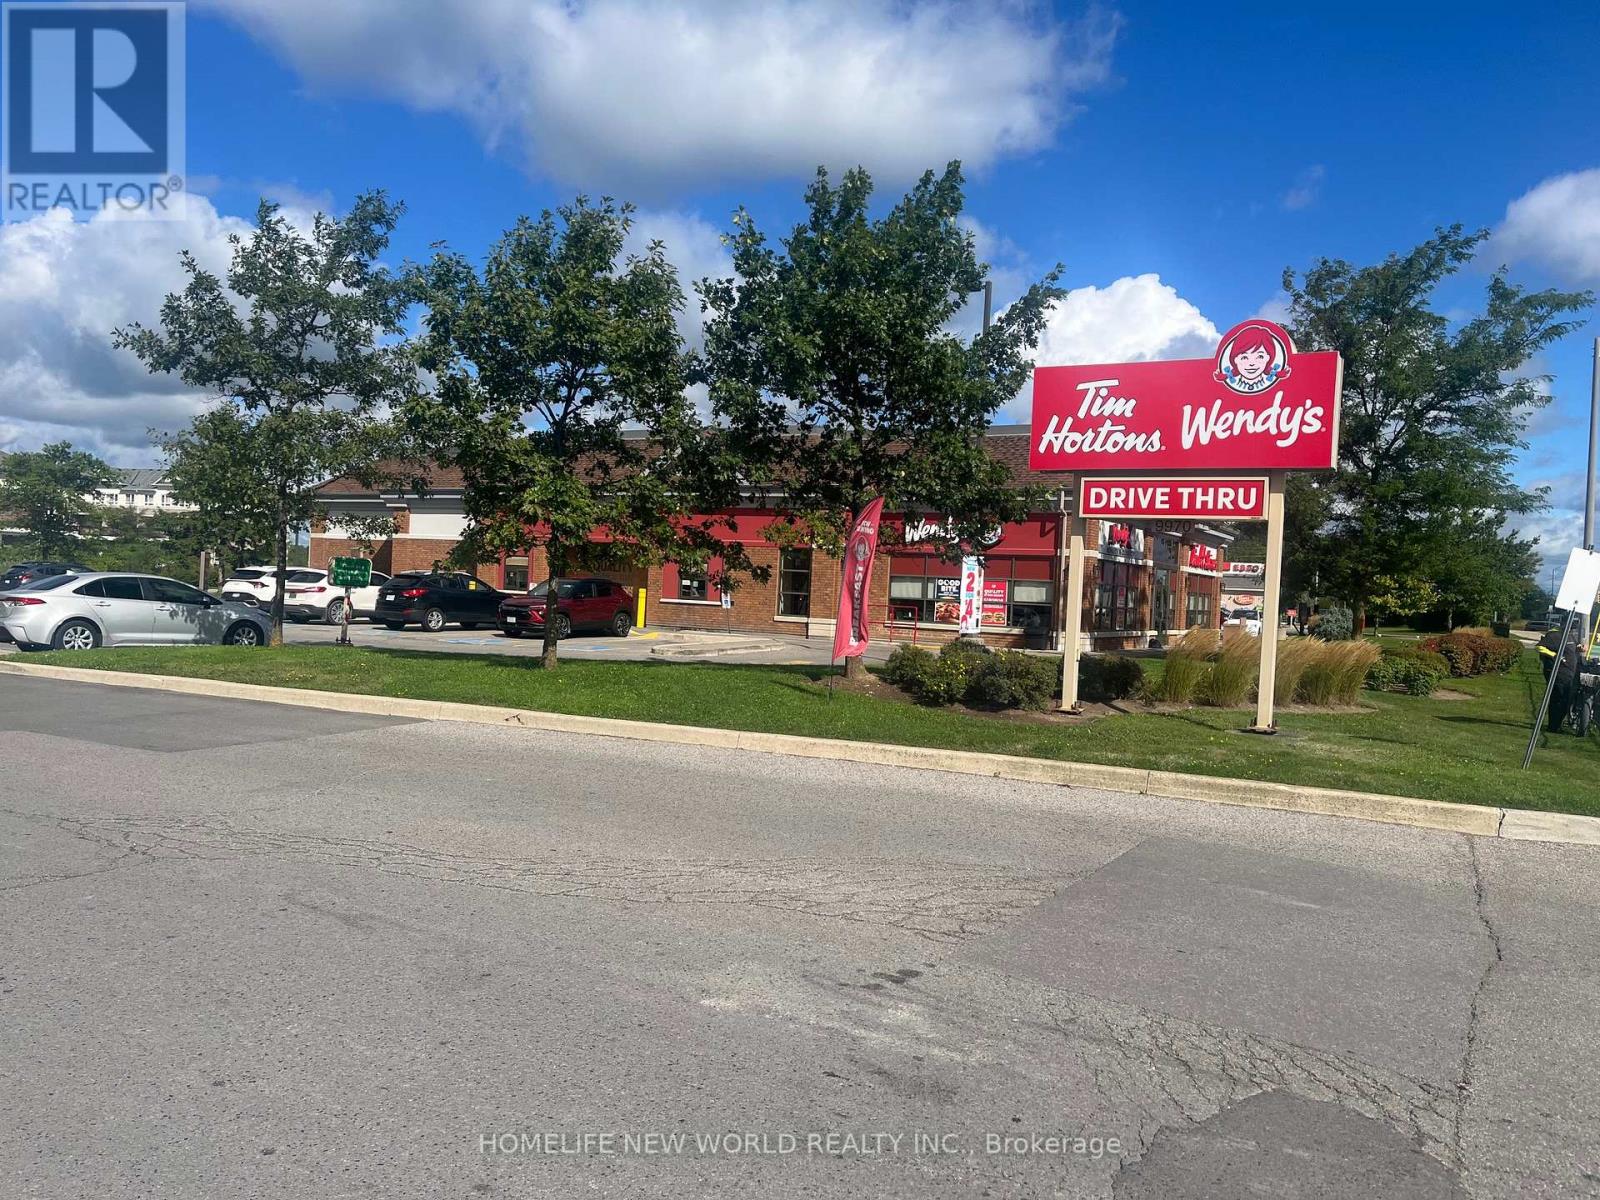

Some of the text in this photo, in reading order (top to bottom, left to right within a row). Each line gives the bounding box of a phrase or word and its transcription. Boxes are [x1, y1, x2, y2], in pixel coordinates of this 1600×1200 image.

[1077, 380, 1137, 419] Tim
[1182, 392, 1325, 450] Wendy's
[1039, 415, 1162, 454] Hortons
[1090, 487, 1257, 510] DRIVE THRU
[1155, 521, 1191, 533] 9970
[938, 579, 960, 587] GOOD
[966, 571, 975, 592] 2
